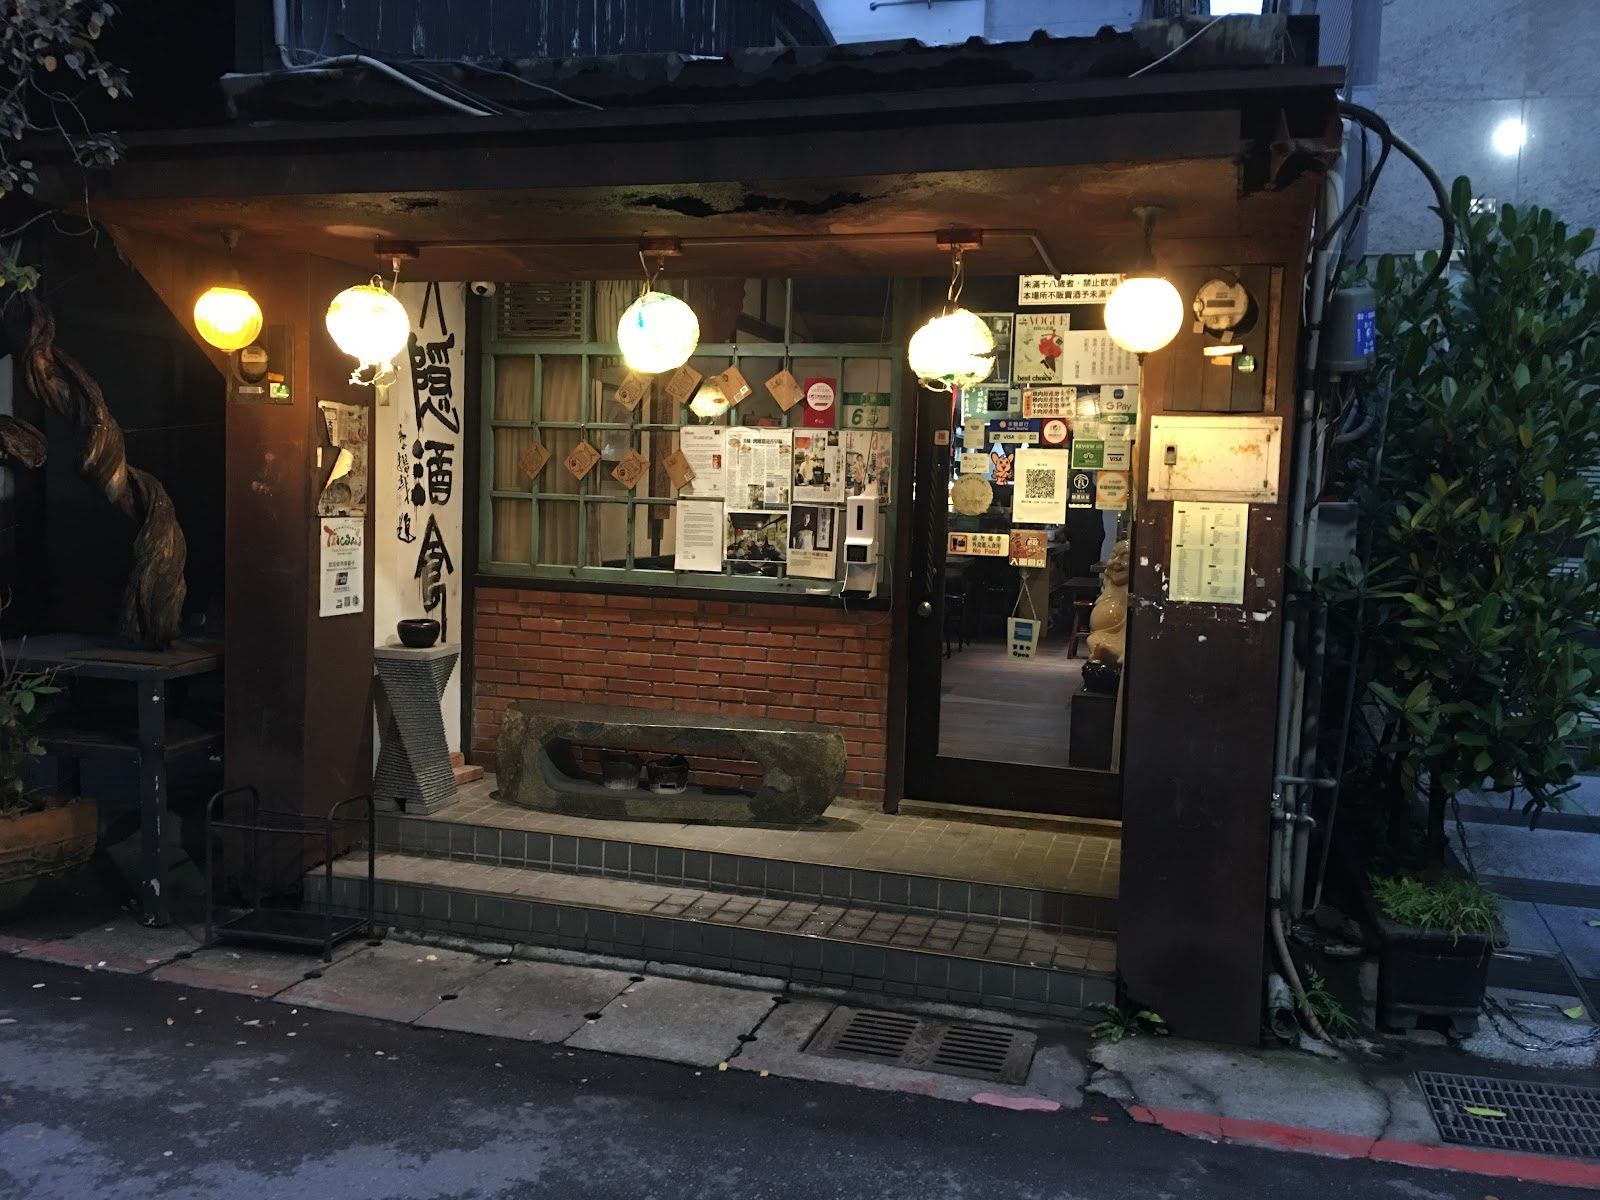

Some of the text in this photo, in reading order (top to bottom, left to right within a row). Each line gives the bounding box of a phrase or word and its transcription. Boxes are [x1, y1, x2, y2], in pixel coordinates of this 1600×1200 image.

[1029, 315, 1068, 326] VOGUE
[1116, 401, 1132, 411] Pay
[1012, 650, 1030, 658] Open
